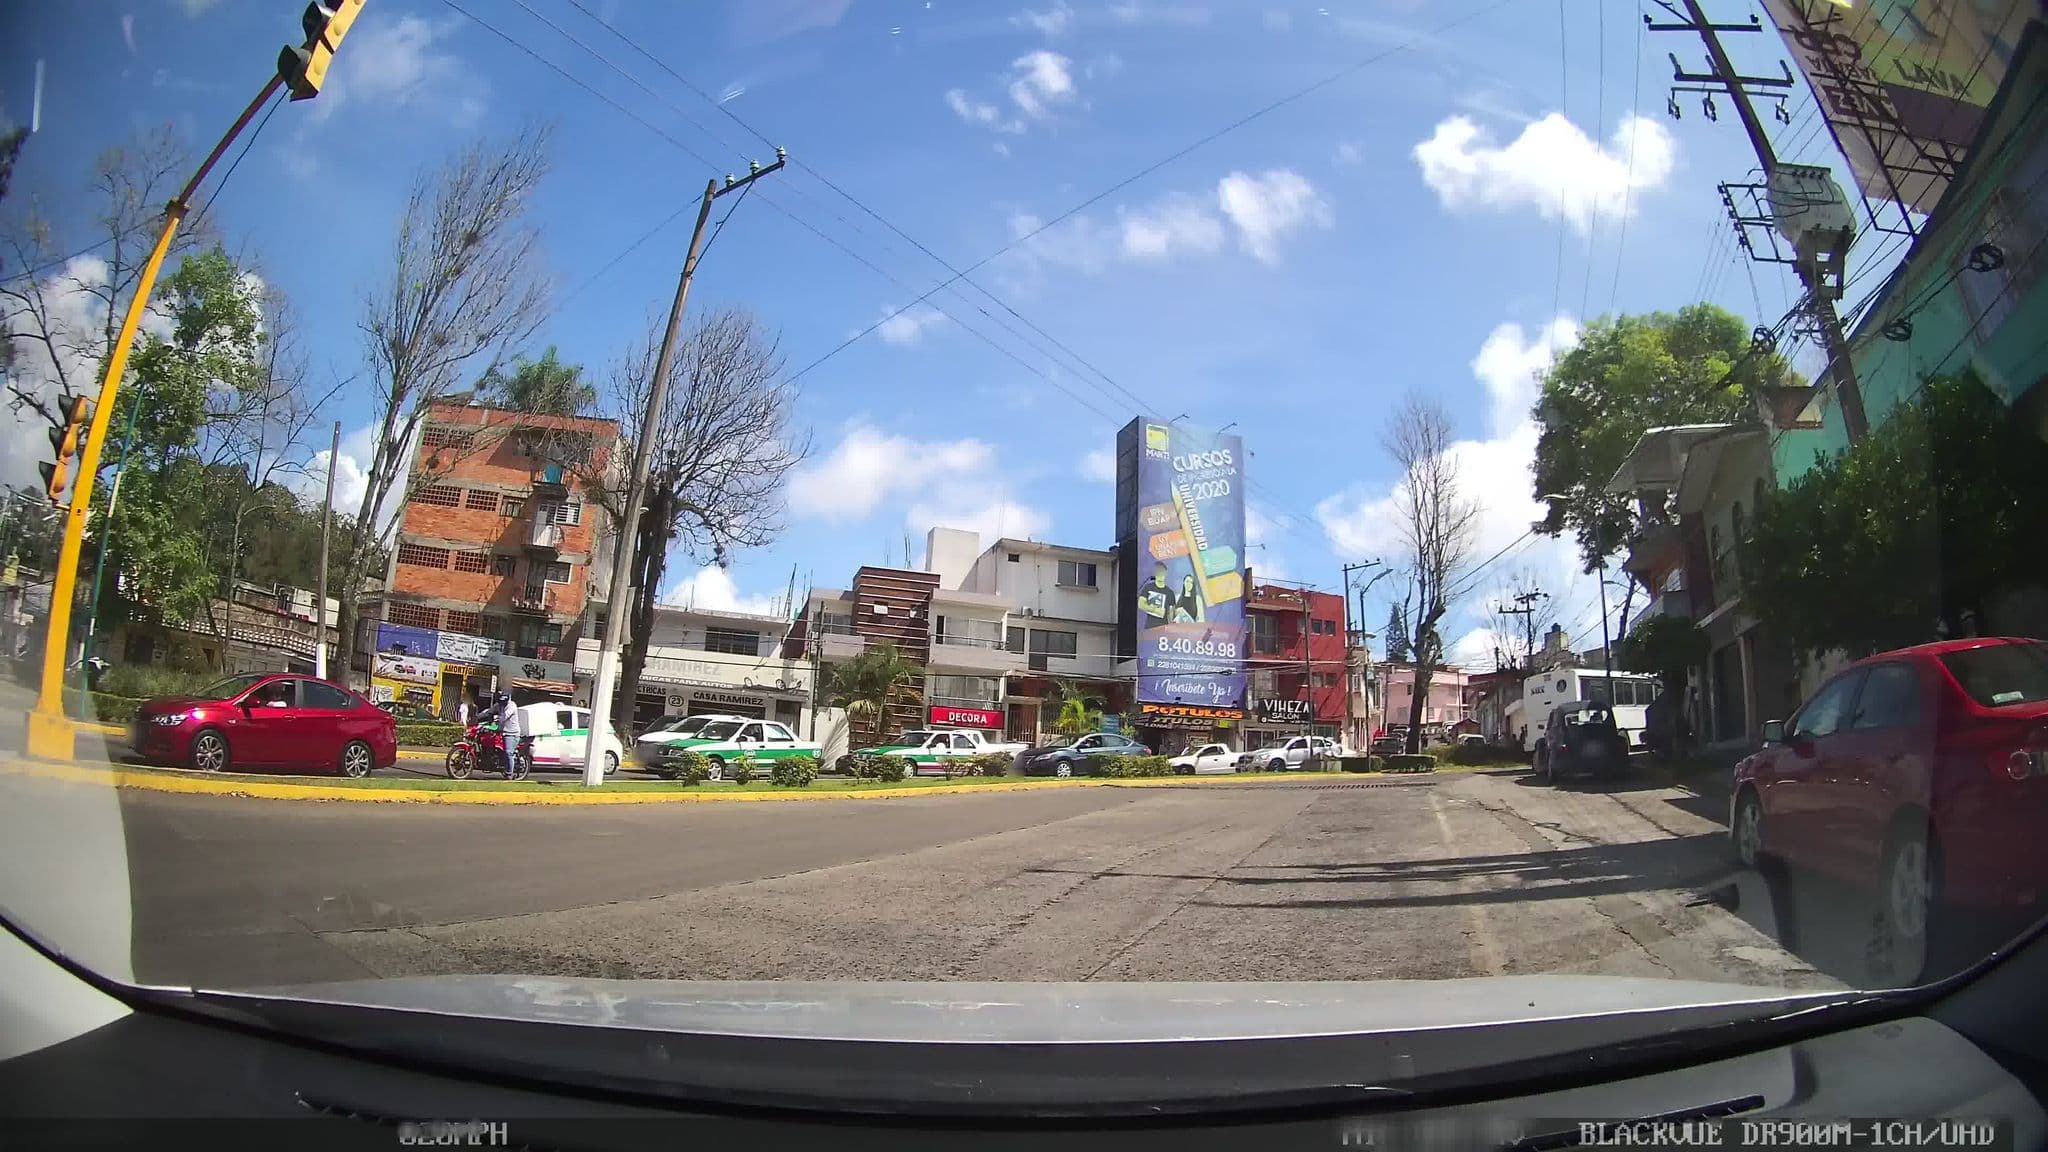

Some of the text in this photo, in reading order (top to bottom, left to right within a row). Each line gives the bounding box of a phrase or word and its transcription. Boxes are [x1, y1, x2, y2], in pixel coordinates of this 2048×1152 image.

[1173, 449, 1232, 472] CURSOS
[1192, 479, 1230, 501] 2020
[1179, 483, 1209, 551] UNIVERSIDAD
[1158, 636, 1236, 658] 8.40.89.98
[672, 696, 682, 705] 23
[693, 691, 764, 706] CASA RAMIREZ
[1264, 699, 1310, 713] VIHEZA
[949, 711, 988, 723] DECORA
